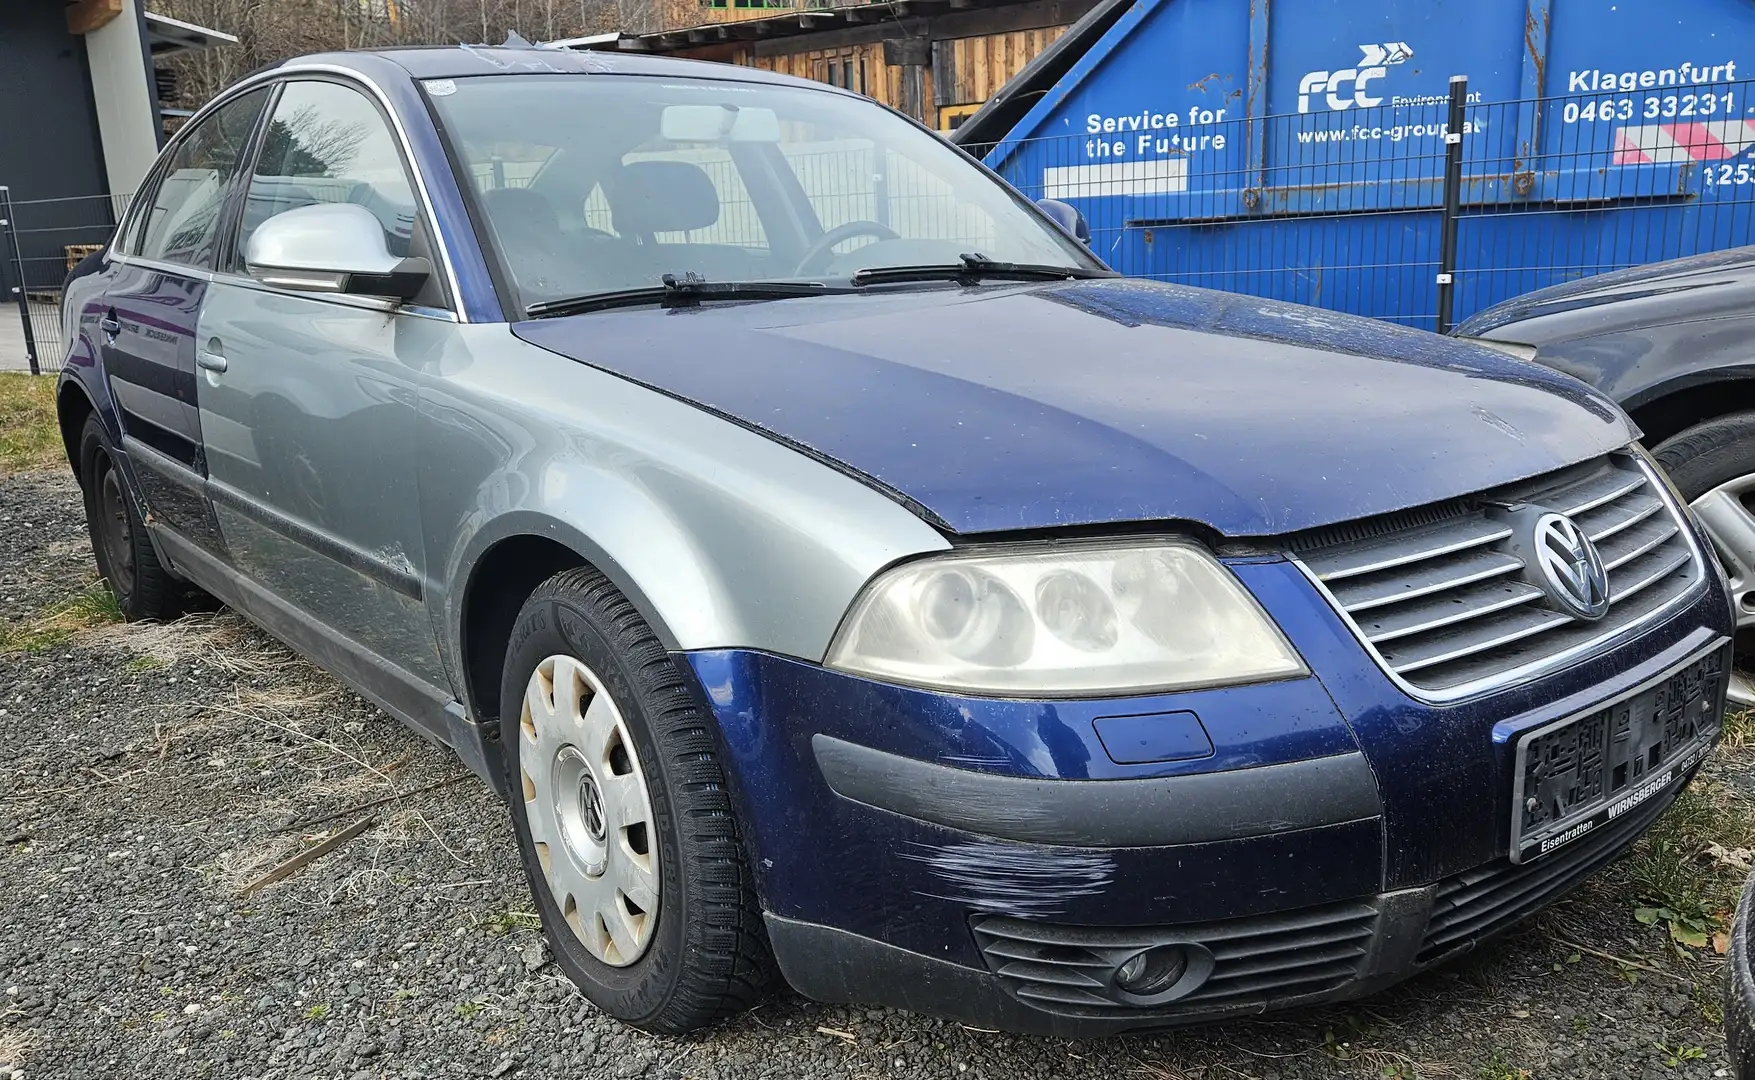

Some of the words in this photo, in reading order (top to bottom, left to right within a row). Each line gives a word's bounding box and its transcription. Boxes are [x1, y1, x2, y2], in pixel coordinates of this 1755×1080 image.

[1298, 67, 1386, 113] FCC
[1568, 61, 1736, 92] Klagenfurt
[1391, 91, 1481, 108] Environnt
[1563, 99, 1633, 124] 0463
[1643, 92, 1735, 119] 33231
[1087, 110, 1179, 133] Service
[1188, 106, 1227, 125] for
[1297, 120, 1481, 143] www.fcc-groupat
[1086, 138, 1126, 158] the
[1138, 133, 1226, 155] Future
[1541, 819, 1594, 853] Eisentratten
[1607, 770, 1673, 819] WIRNSBERGER
